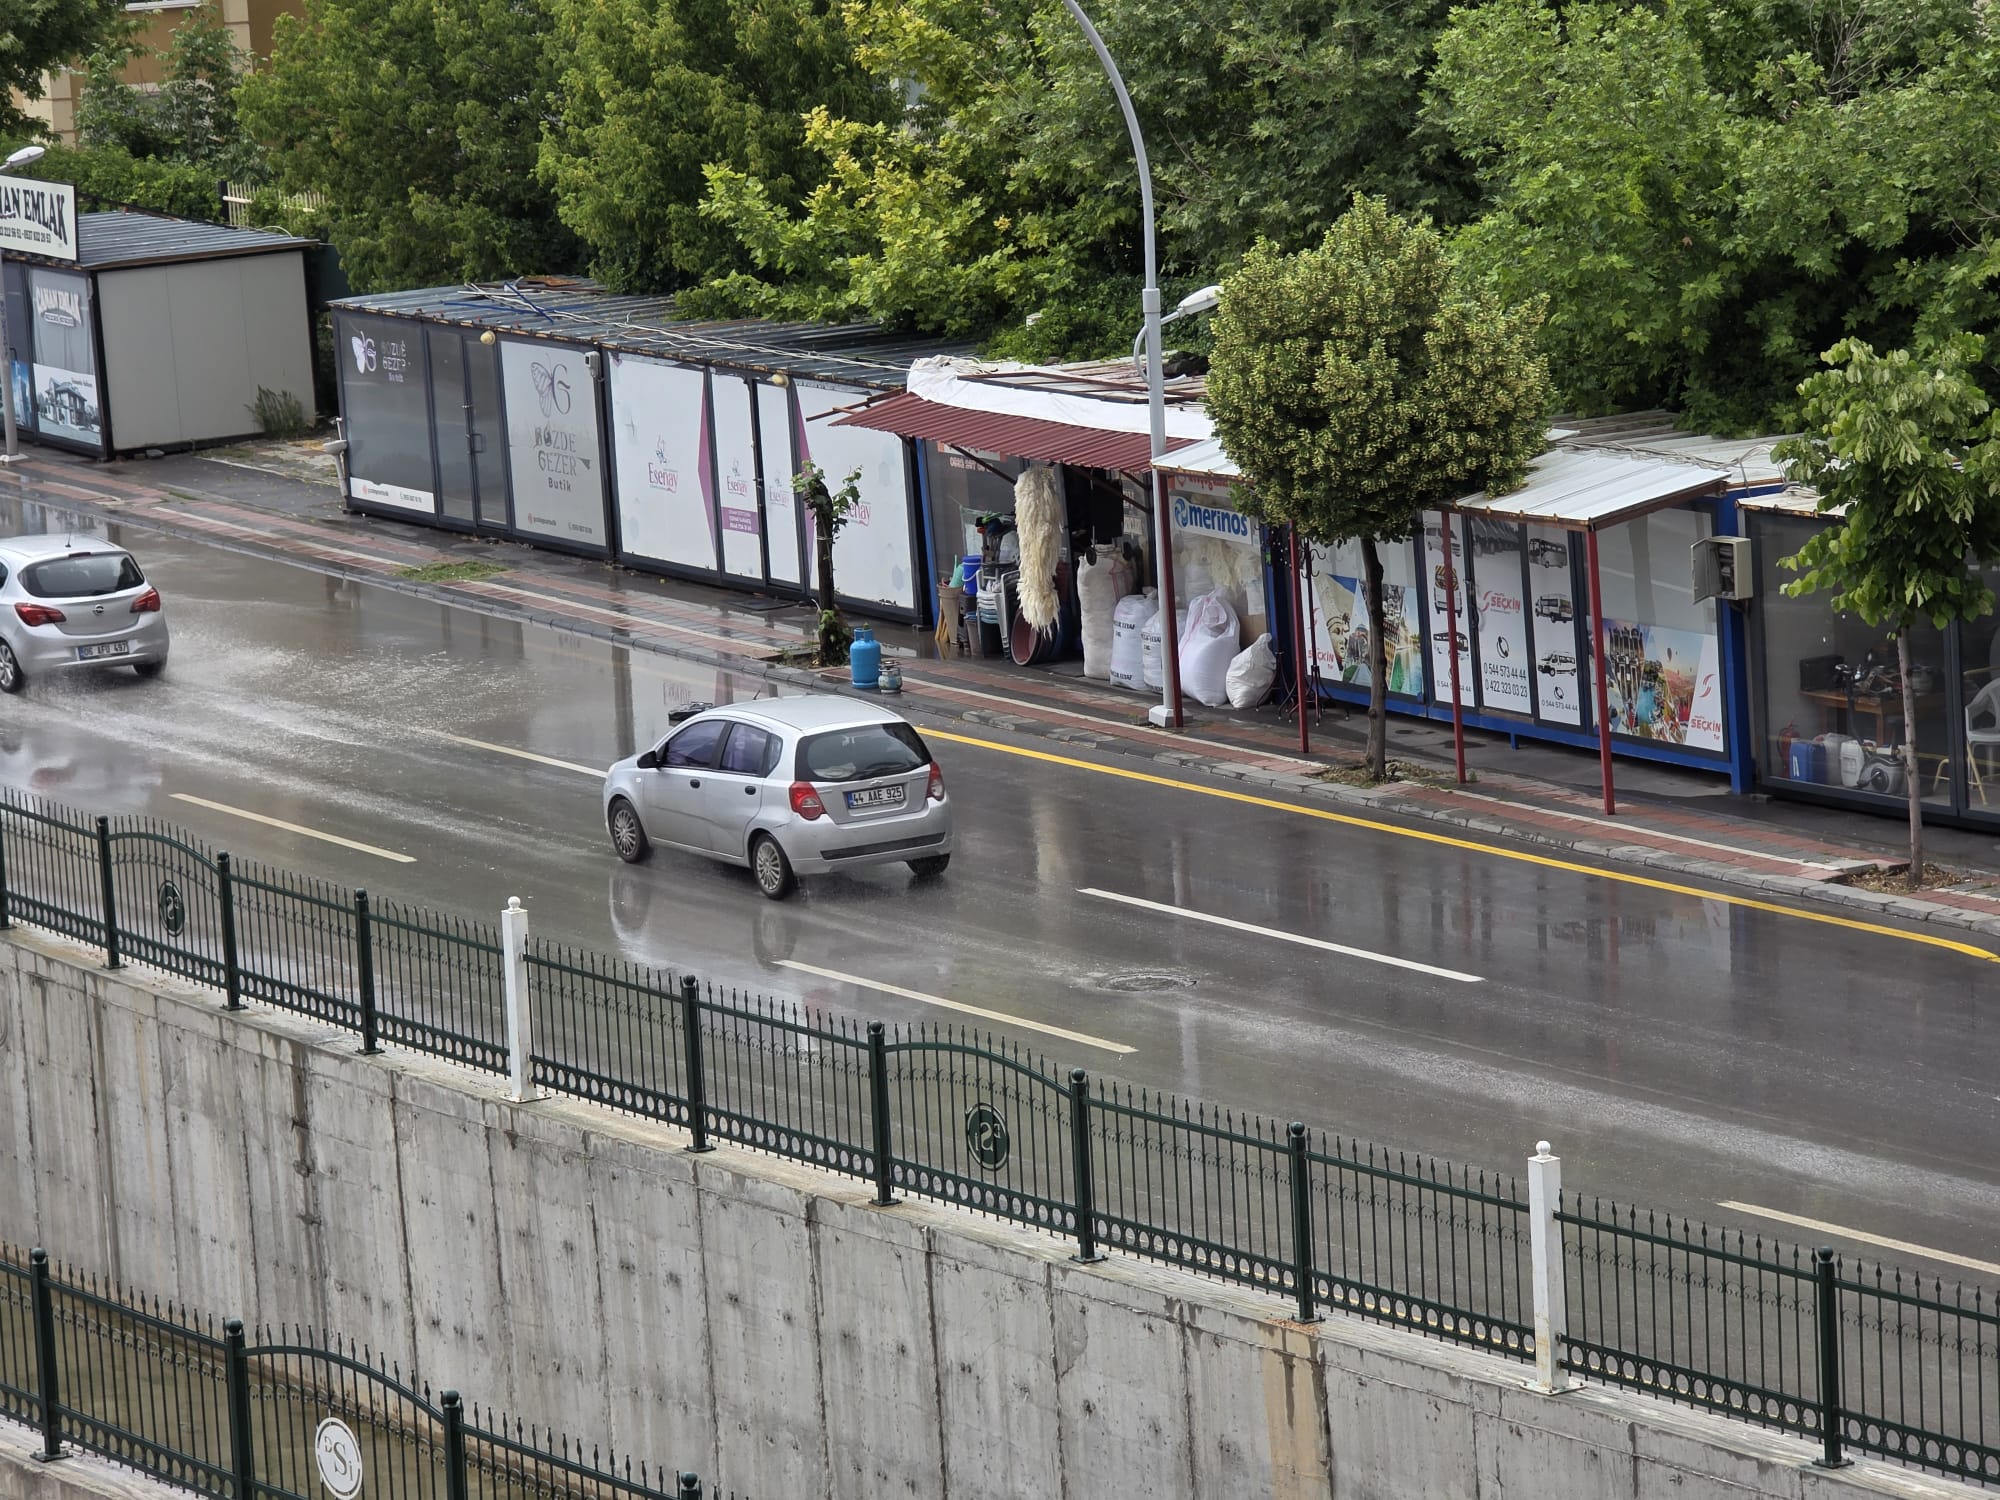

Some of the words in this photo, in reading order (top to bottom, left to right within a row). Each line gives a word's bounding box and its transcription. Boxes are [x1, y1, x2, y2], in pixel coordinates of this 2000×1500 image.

[22, 189, 68, 245] EMLAK
[547, 476, 572, 493] Butik
[648, 462, 678, 490] Esenay
[1188, 504, 1248, 537] merinos
[1488, 663, 1499, 676] 544
[1500, 665, 1511, 678] 573
[1511, 667, 1519, 680] 44
[1519, 669, 1527, 681] 44
[1490, 680, 1501, 693] 422
[1501, 682, 1512, 695] 323
[1512, 684, 1520, 696] 03
[1520, 685, 1528, 698] 23
[1690, 718, 1721, 733] SEÇKİN
[853, 792, 864, 805] 44
[868, 789, 883, 802] AAE
[886, 786, 902, 799] 925
